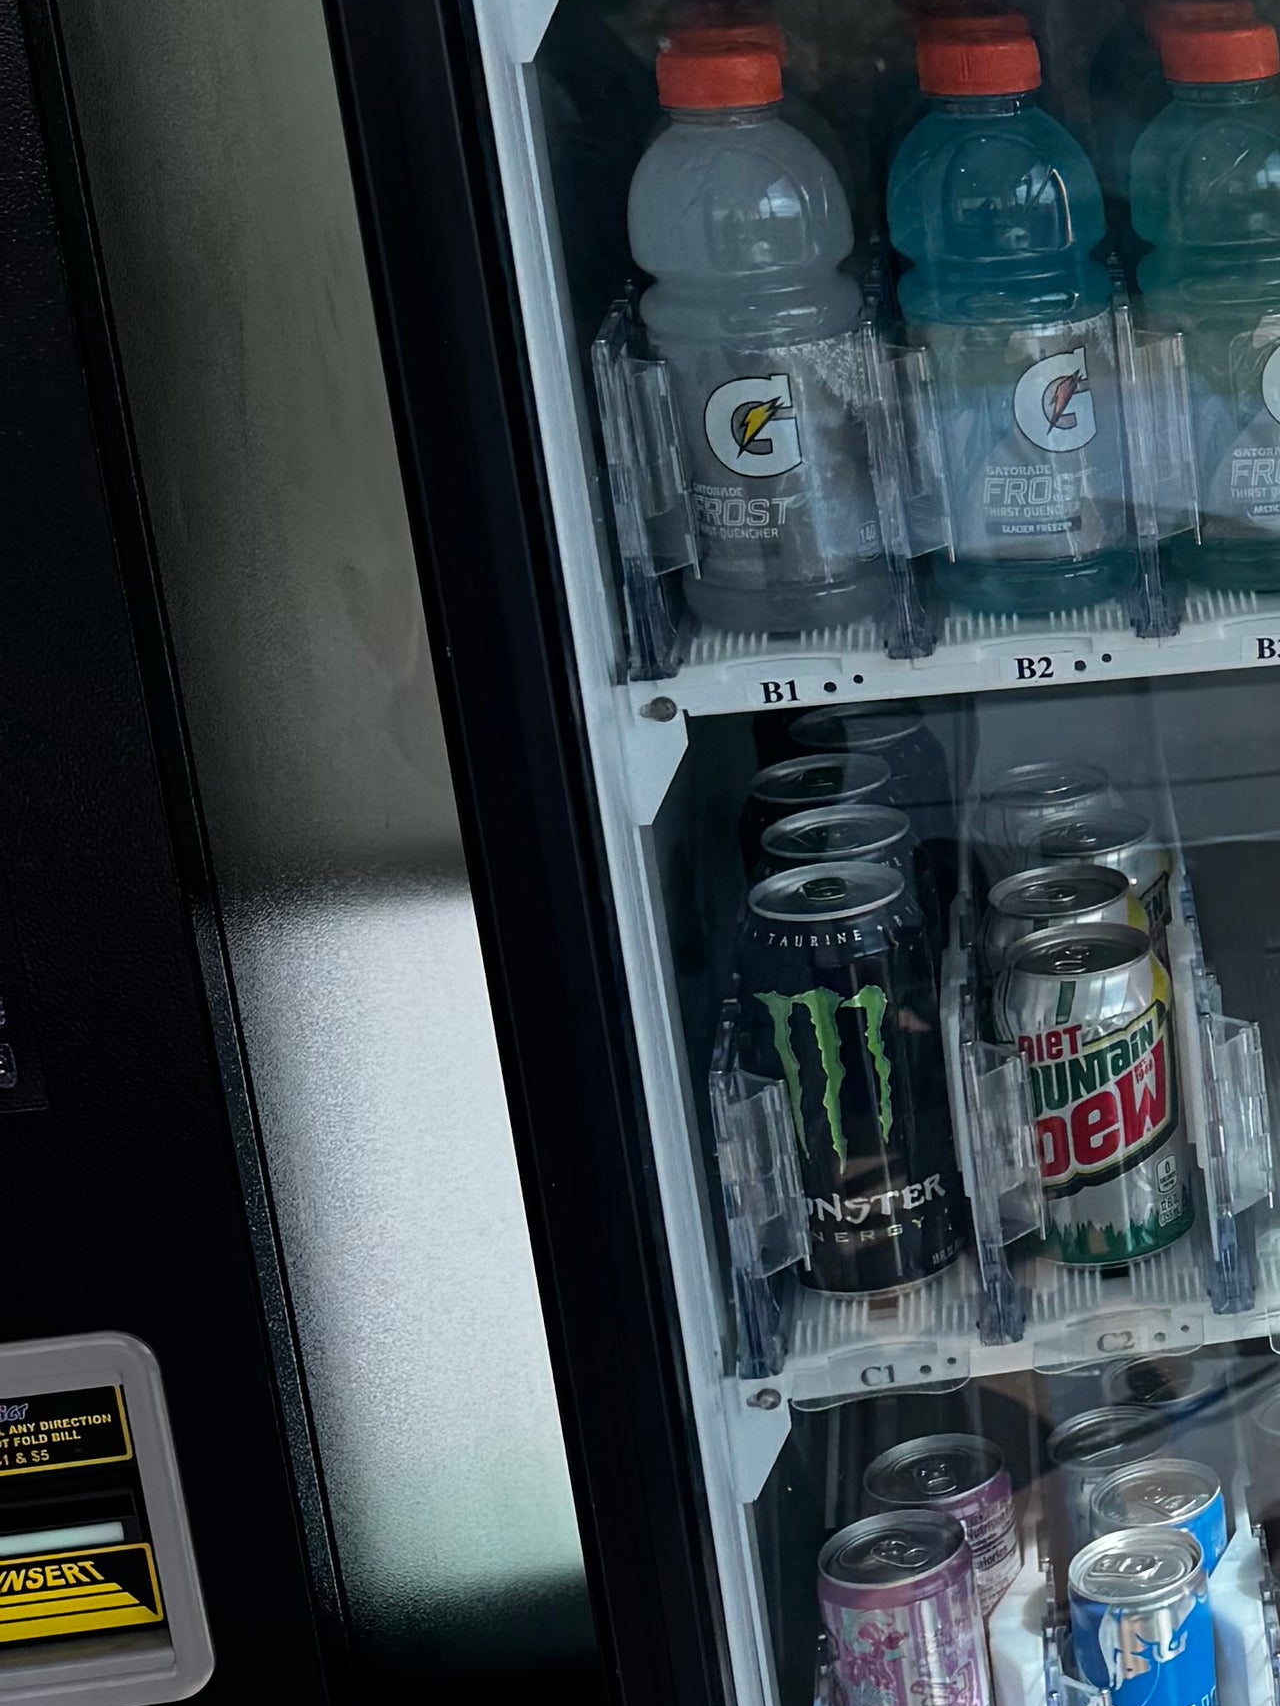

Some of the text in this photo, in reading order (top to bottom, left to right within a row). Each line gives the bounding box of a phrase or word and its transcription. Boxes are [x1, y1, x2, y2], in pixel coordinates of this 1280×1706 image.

[1013, 346, 1097, 453] G
[704, 373, 802, 478] G
[987, 465, 1052, 476] GATORADE
[1231, 487, 1267, 498] THIRST
[984, 505, 1021, 518] THIRST
[720, 527, 779, 539] QUENCHER
[1015, 656, 1055, 681] B2
[762, 679, 802, 704] B1
[767, 929, 863, 948] TAURINE
[808, 1173, 947, 1225] NSTER
[1096, 1331, 1135, 1354] C2
[859, 1365, 896, 1388] C1
[9, 1413, 112, 1435] ANY DIRECTION
[14, 1430, 81, 1447] FOLD BILL
[15, 1449, 50, 1463] & $5
